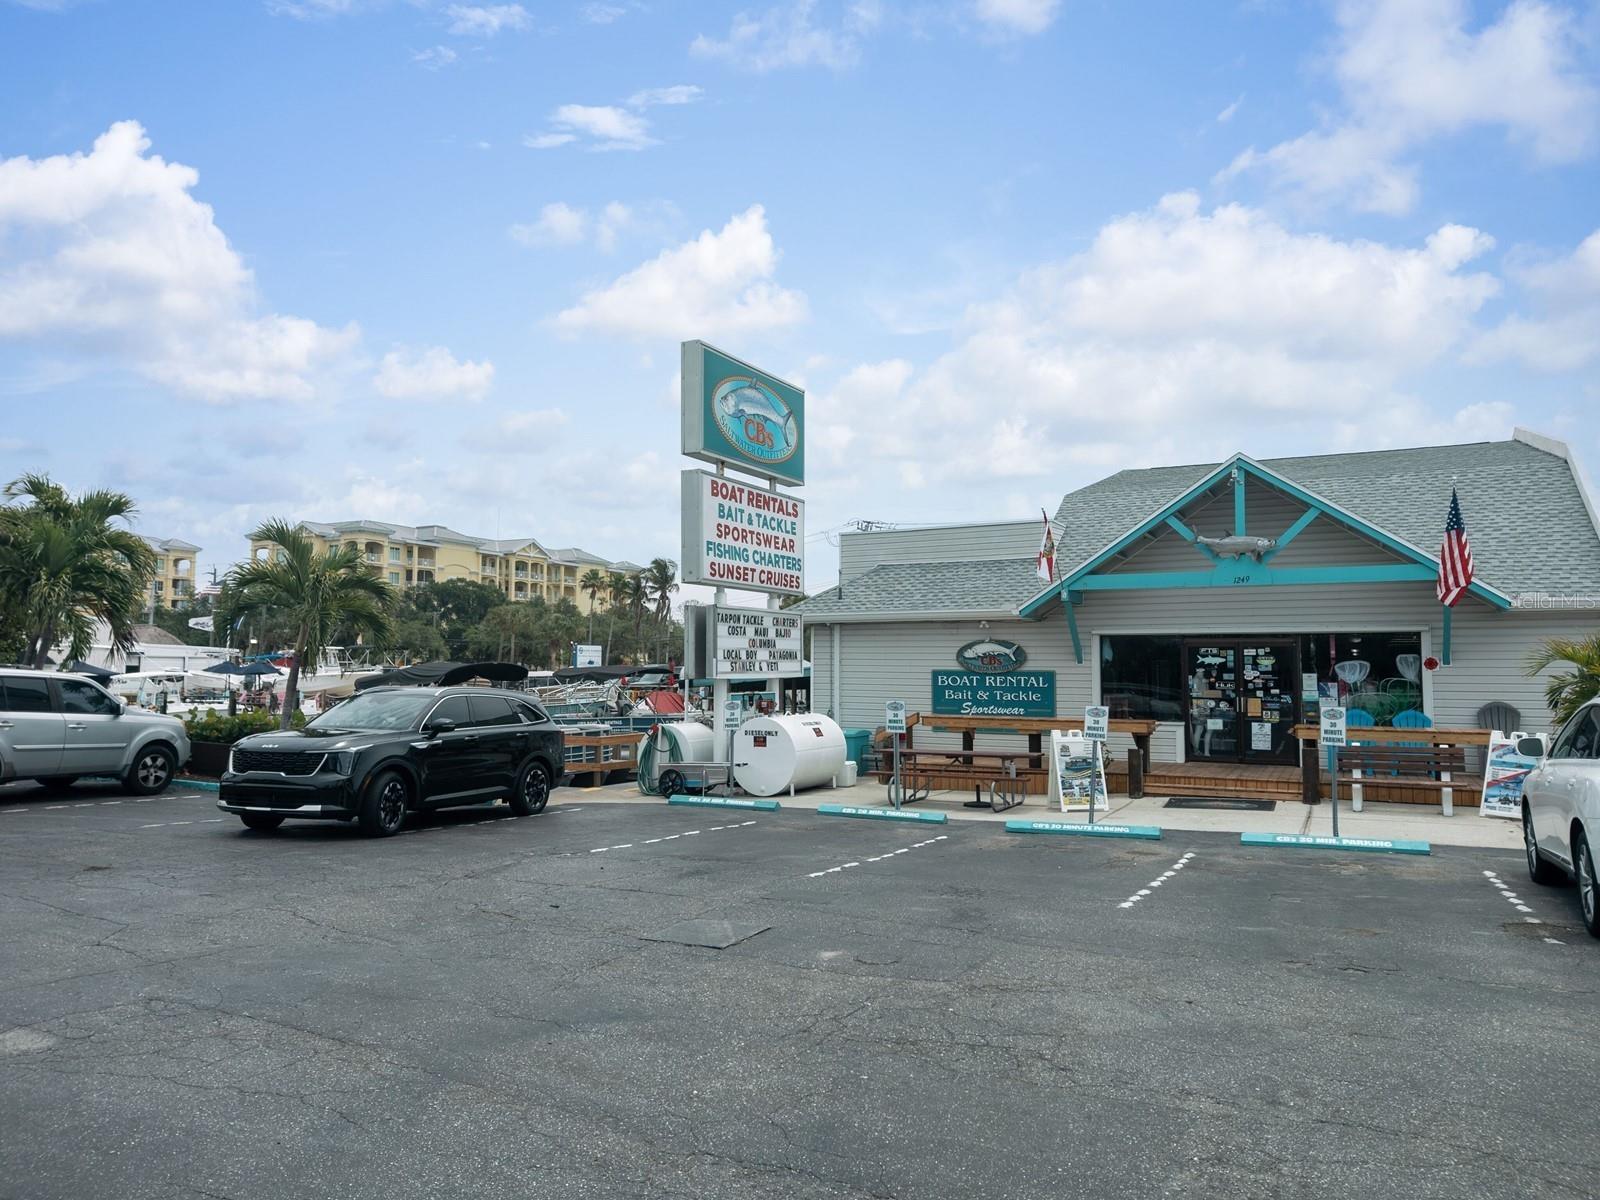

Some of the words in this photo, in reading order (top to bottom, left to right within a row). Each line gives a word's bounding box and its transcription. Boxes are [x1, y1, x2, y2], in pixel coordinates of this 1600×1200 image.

[711, 479, 744, 504] BOAT
[747, 490, 799, 518] RENTALS
[718, 503, 745, 524] BAIT
[747, 513, 754, 526] &
[755, 513, 797, 536] TACKLE
[716, 523, 795, 553] SPORTSWEAR
[706, 540, 749, 563] FISHING
[752, 550, 801, 572] CHARTERS
[709, 562, 756, 583] SUNSET
[758, 570, 801, 590] CRUISES
[1233, 576, 1250, 584] 1249
[717, 612, 741, 625] TARPON
[742, 615, 764, 626] TACKLE
[772, 617, 799, 628] CHARTERS
[727, 626, 747, 636] COSTA
[754, 627, 769, 637] MAUI
[748, 639, 777, 649] COLUMBIA
[723, 649, 742, 660] LOCAL
[745, 650, 758, 660] BOY
[768, 651, 798, 661] PATAGONIA
[730, 661, 756, 672] STANLEY
[766, 662, 779, 671] YETI
[938, 675, 980, 686] BOAT
[985, 676, 1048, 688] RENTAL
[945, 690, 972, 699] Bait
[976, 690, 989, 700] &
[993, 690, 1041, 701] Tackle
[960, 702, 1025, 715] Sportswear
[1094, 825, 1130, 833] PARKING
[1342, 839, 1393, 847] PARKING
